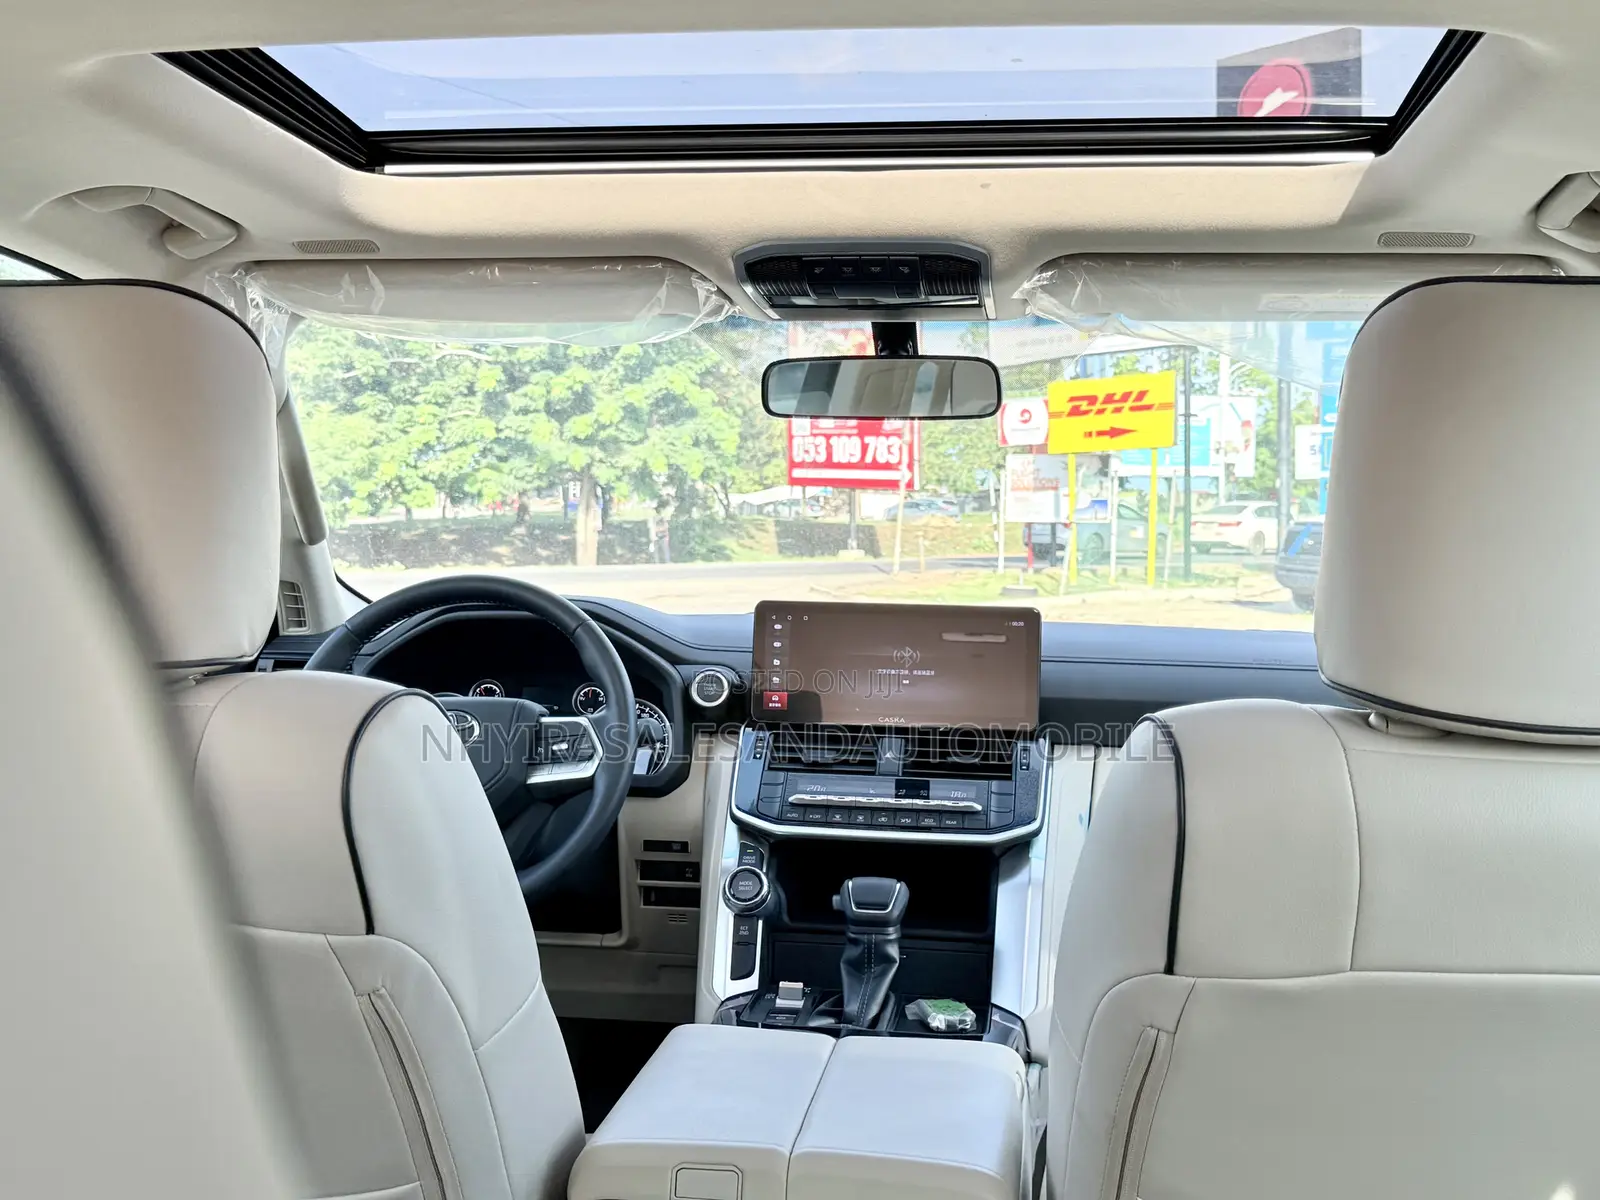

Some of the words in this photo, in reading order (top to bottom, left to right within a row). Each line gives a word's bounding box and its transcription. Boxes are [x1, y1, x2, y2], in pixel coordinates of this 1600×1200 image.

[1066, 389, 1156, 418] DHL
[829, 435, 862, 463] 109
[878, 716, 906, 724] CASKA
